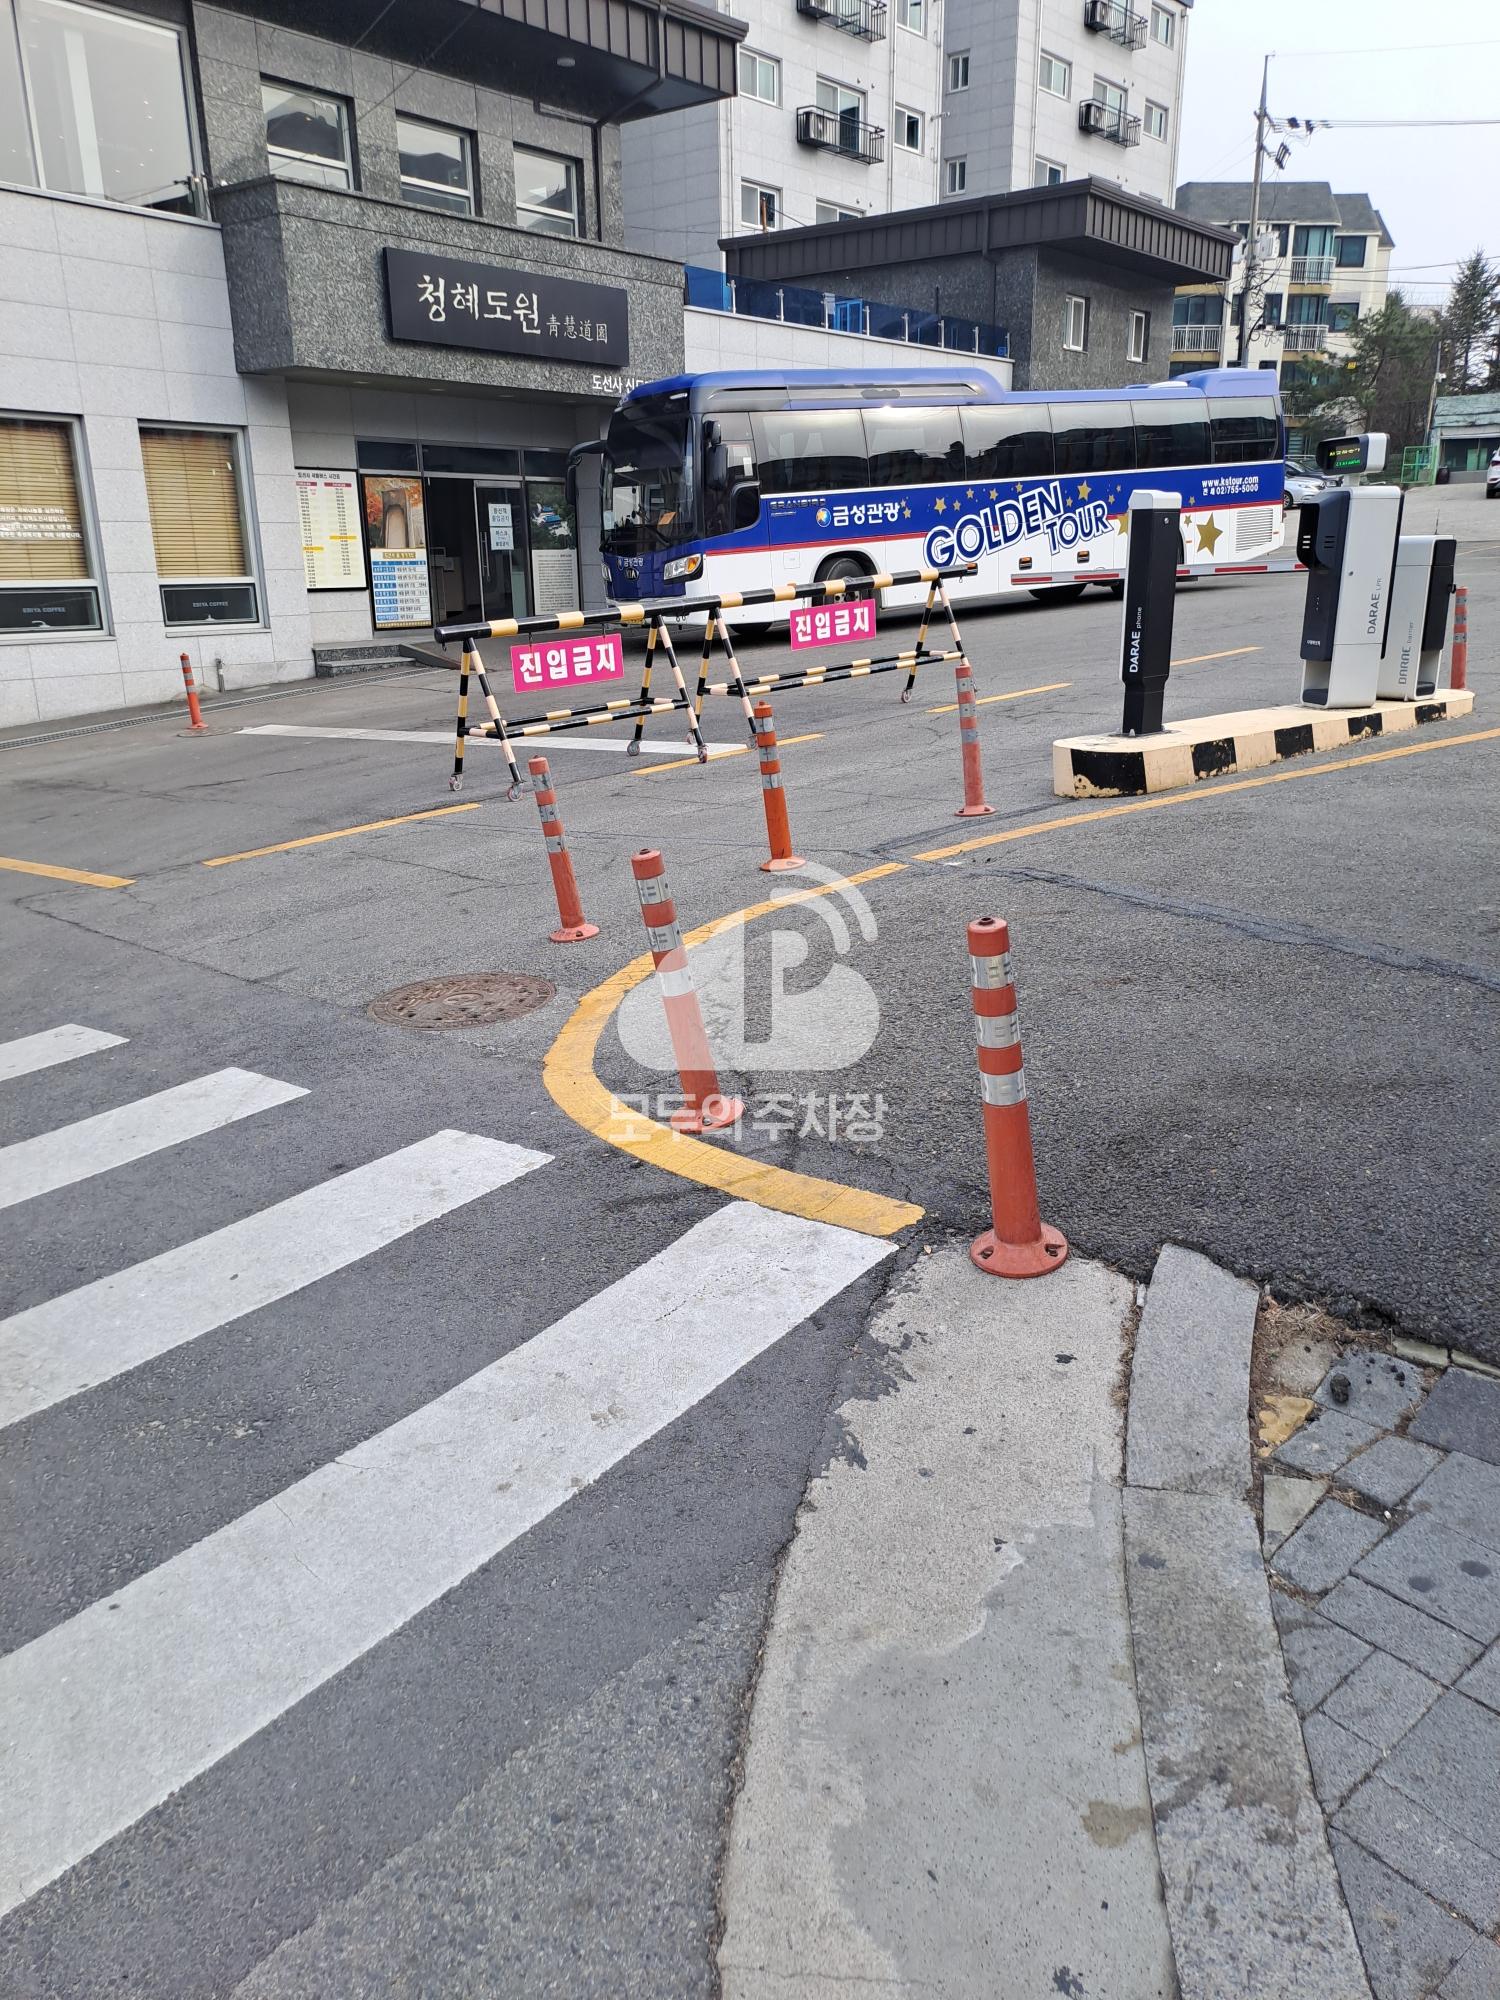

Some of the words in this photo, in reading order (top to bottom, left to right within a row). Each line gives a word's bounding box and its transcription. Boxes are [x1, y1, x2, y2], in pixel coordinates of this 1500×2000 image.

[417, 274, 541, 335] 청혜도원
[546, 314, 608, 344] 青慧道園
[592, 374, 623, 394] 도선사
[1201, 475, 1259, 488] www.kstour.com
[832, 502, 900, 527] 금성관광
[924, 480, 1064, 569] GOLDEN
[1043, 500, 1114, 555] TOUR
[796, 607, 871, 643] 진입금지
[1367, 592, 1381, 635] DARAE
[519, 643, 617, 683] 진입금지
[1129, 631, 1141, 673] DARAE
[1398, 646, 1412, 685] DARAE
